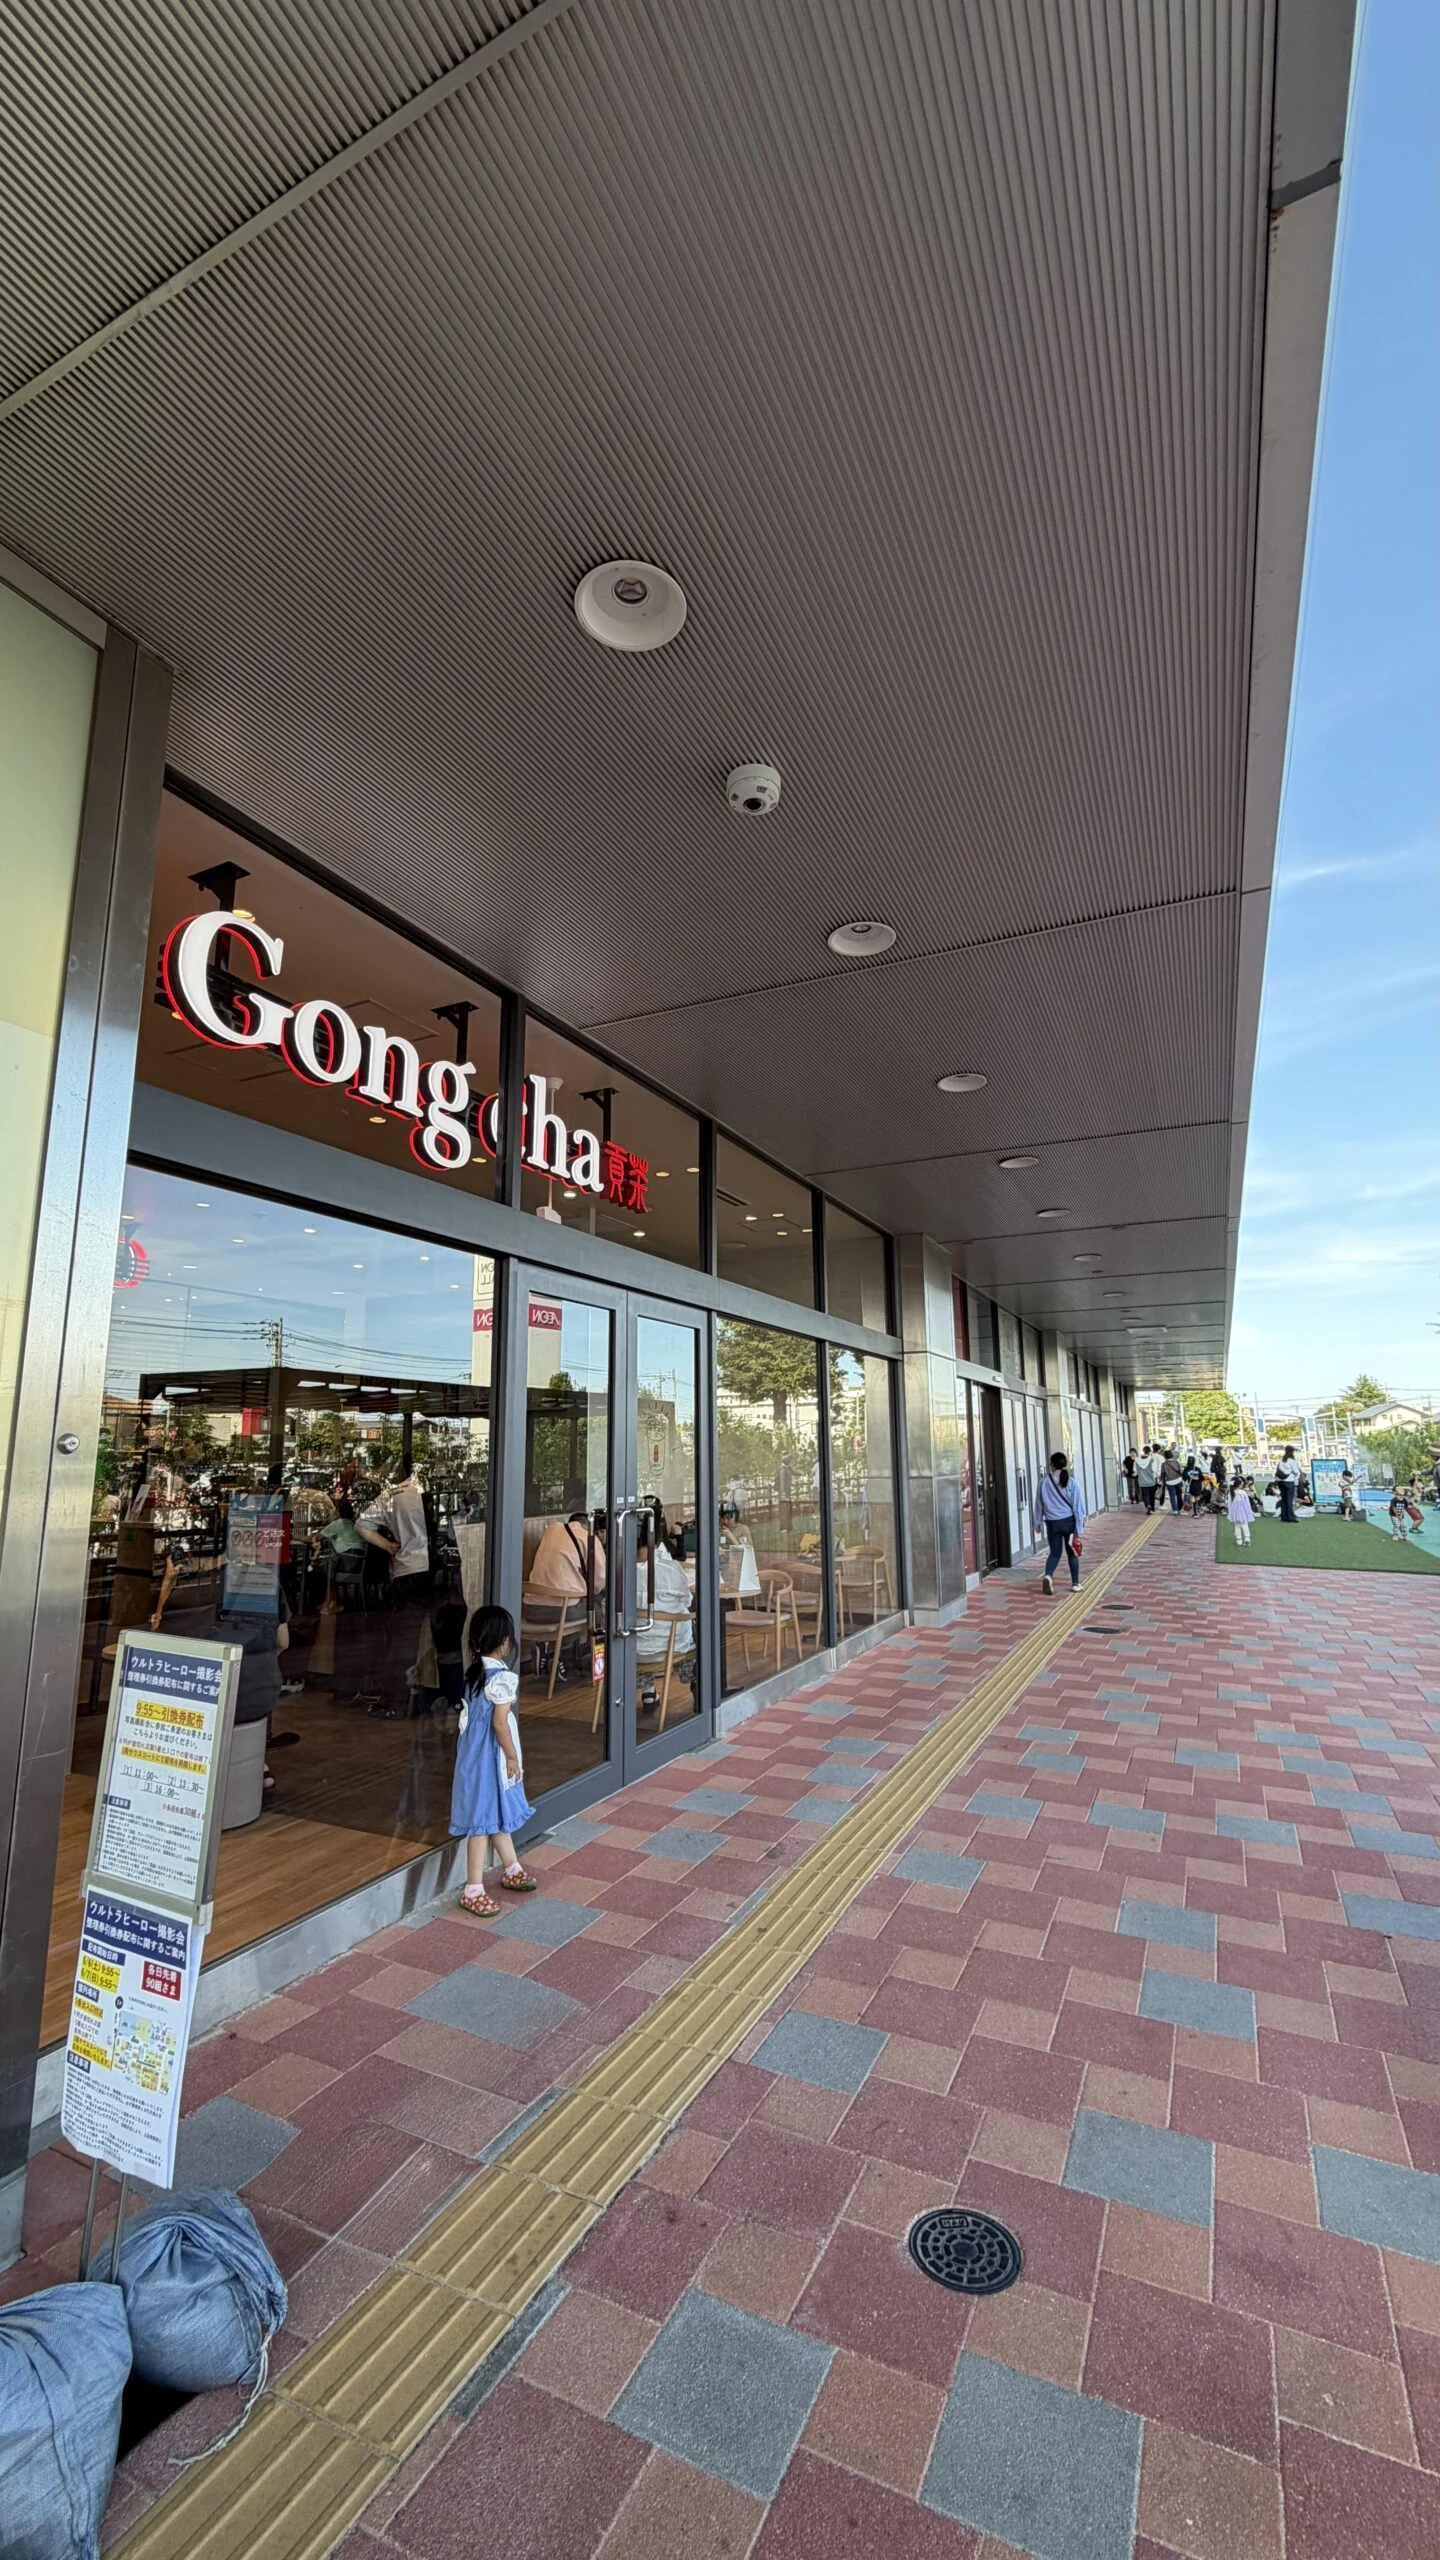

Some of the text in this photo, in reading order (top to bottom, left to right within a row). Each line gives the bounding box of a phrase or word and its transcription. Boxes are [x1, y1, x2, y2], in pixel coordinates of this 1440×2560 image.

[166, 910, 477, 1169] Gong
[131, 1655, 222, 1683] ウルトラヒーロー撮影会
[86, 1916, 186, 1961] 整理券引換券配布に関するご案内
[90, 1901, 186, 1946] ウルトラヒーロー撮影会
[145, 1977, 177, 1996] 90組さま
[147, 1964, 177, 1983] 各日先着
